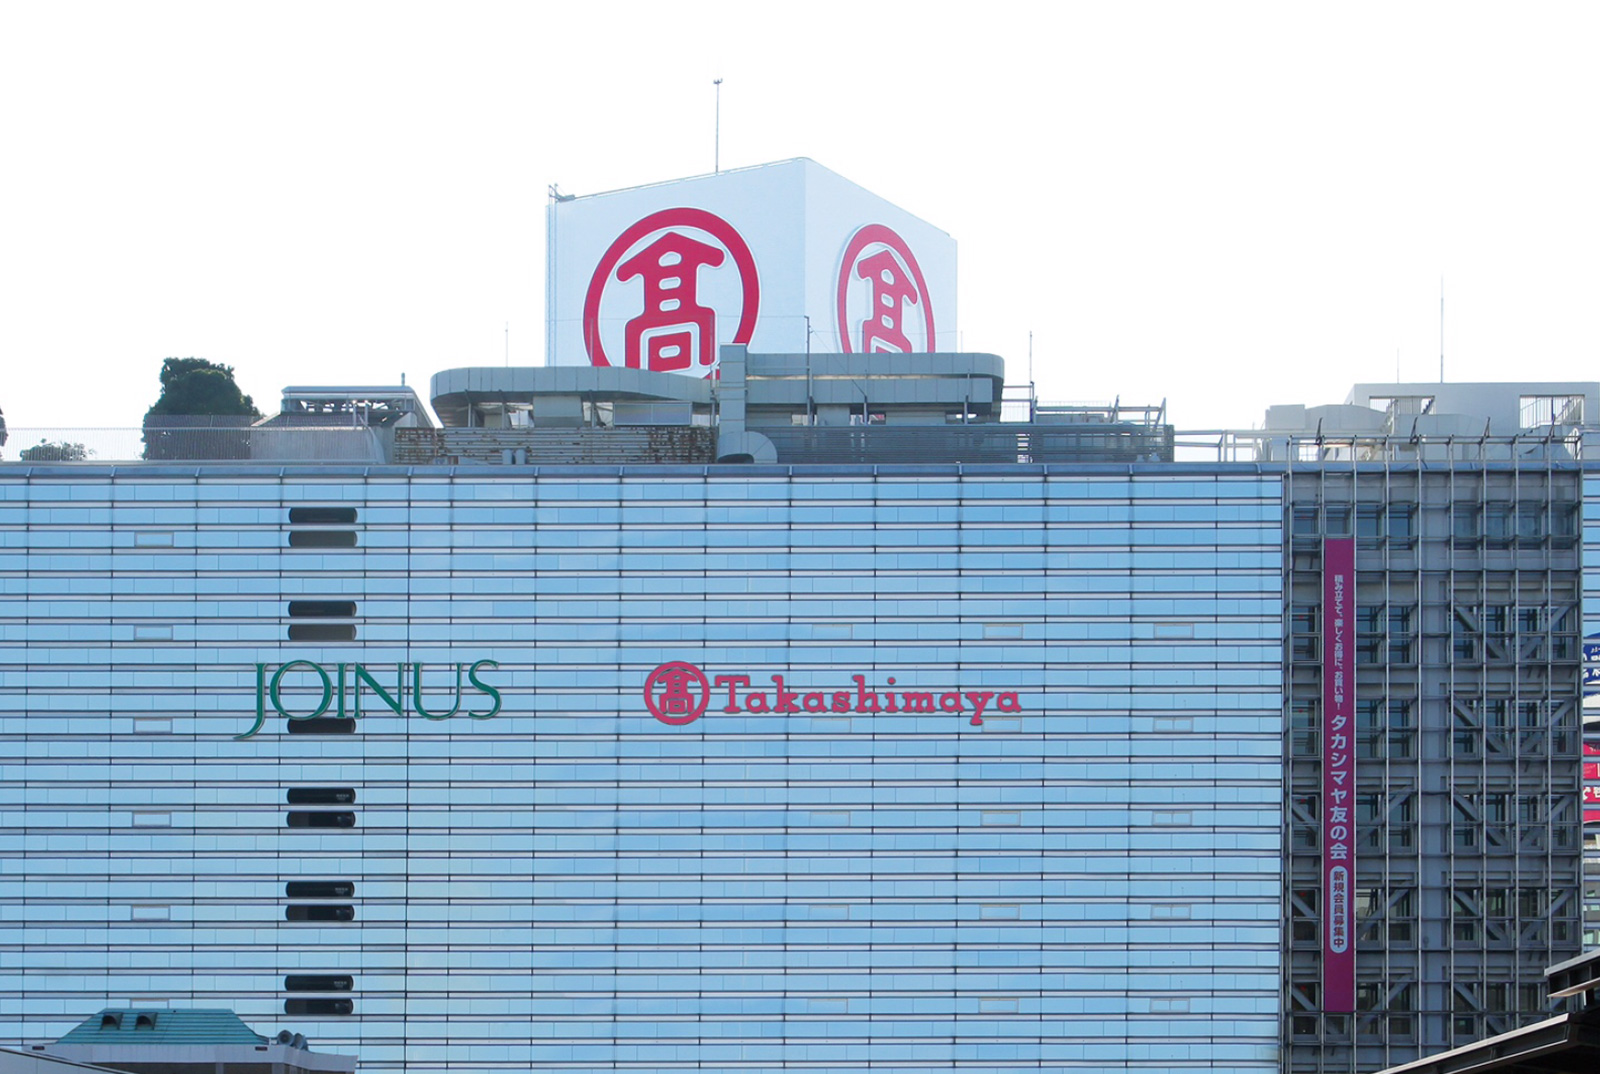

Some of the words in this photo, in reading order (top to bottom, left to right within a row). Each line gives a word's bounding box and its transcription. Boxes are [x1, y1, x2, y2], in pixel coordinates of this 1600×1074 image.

[233, 659, 502, 740] JOINUS
[714, 674, 1022, 726] Takashimaya
[1330, 715, 1348, 860] タカシマヤ友の会
